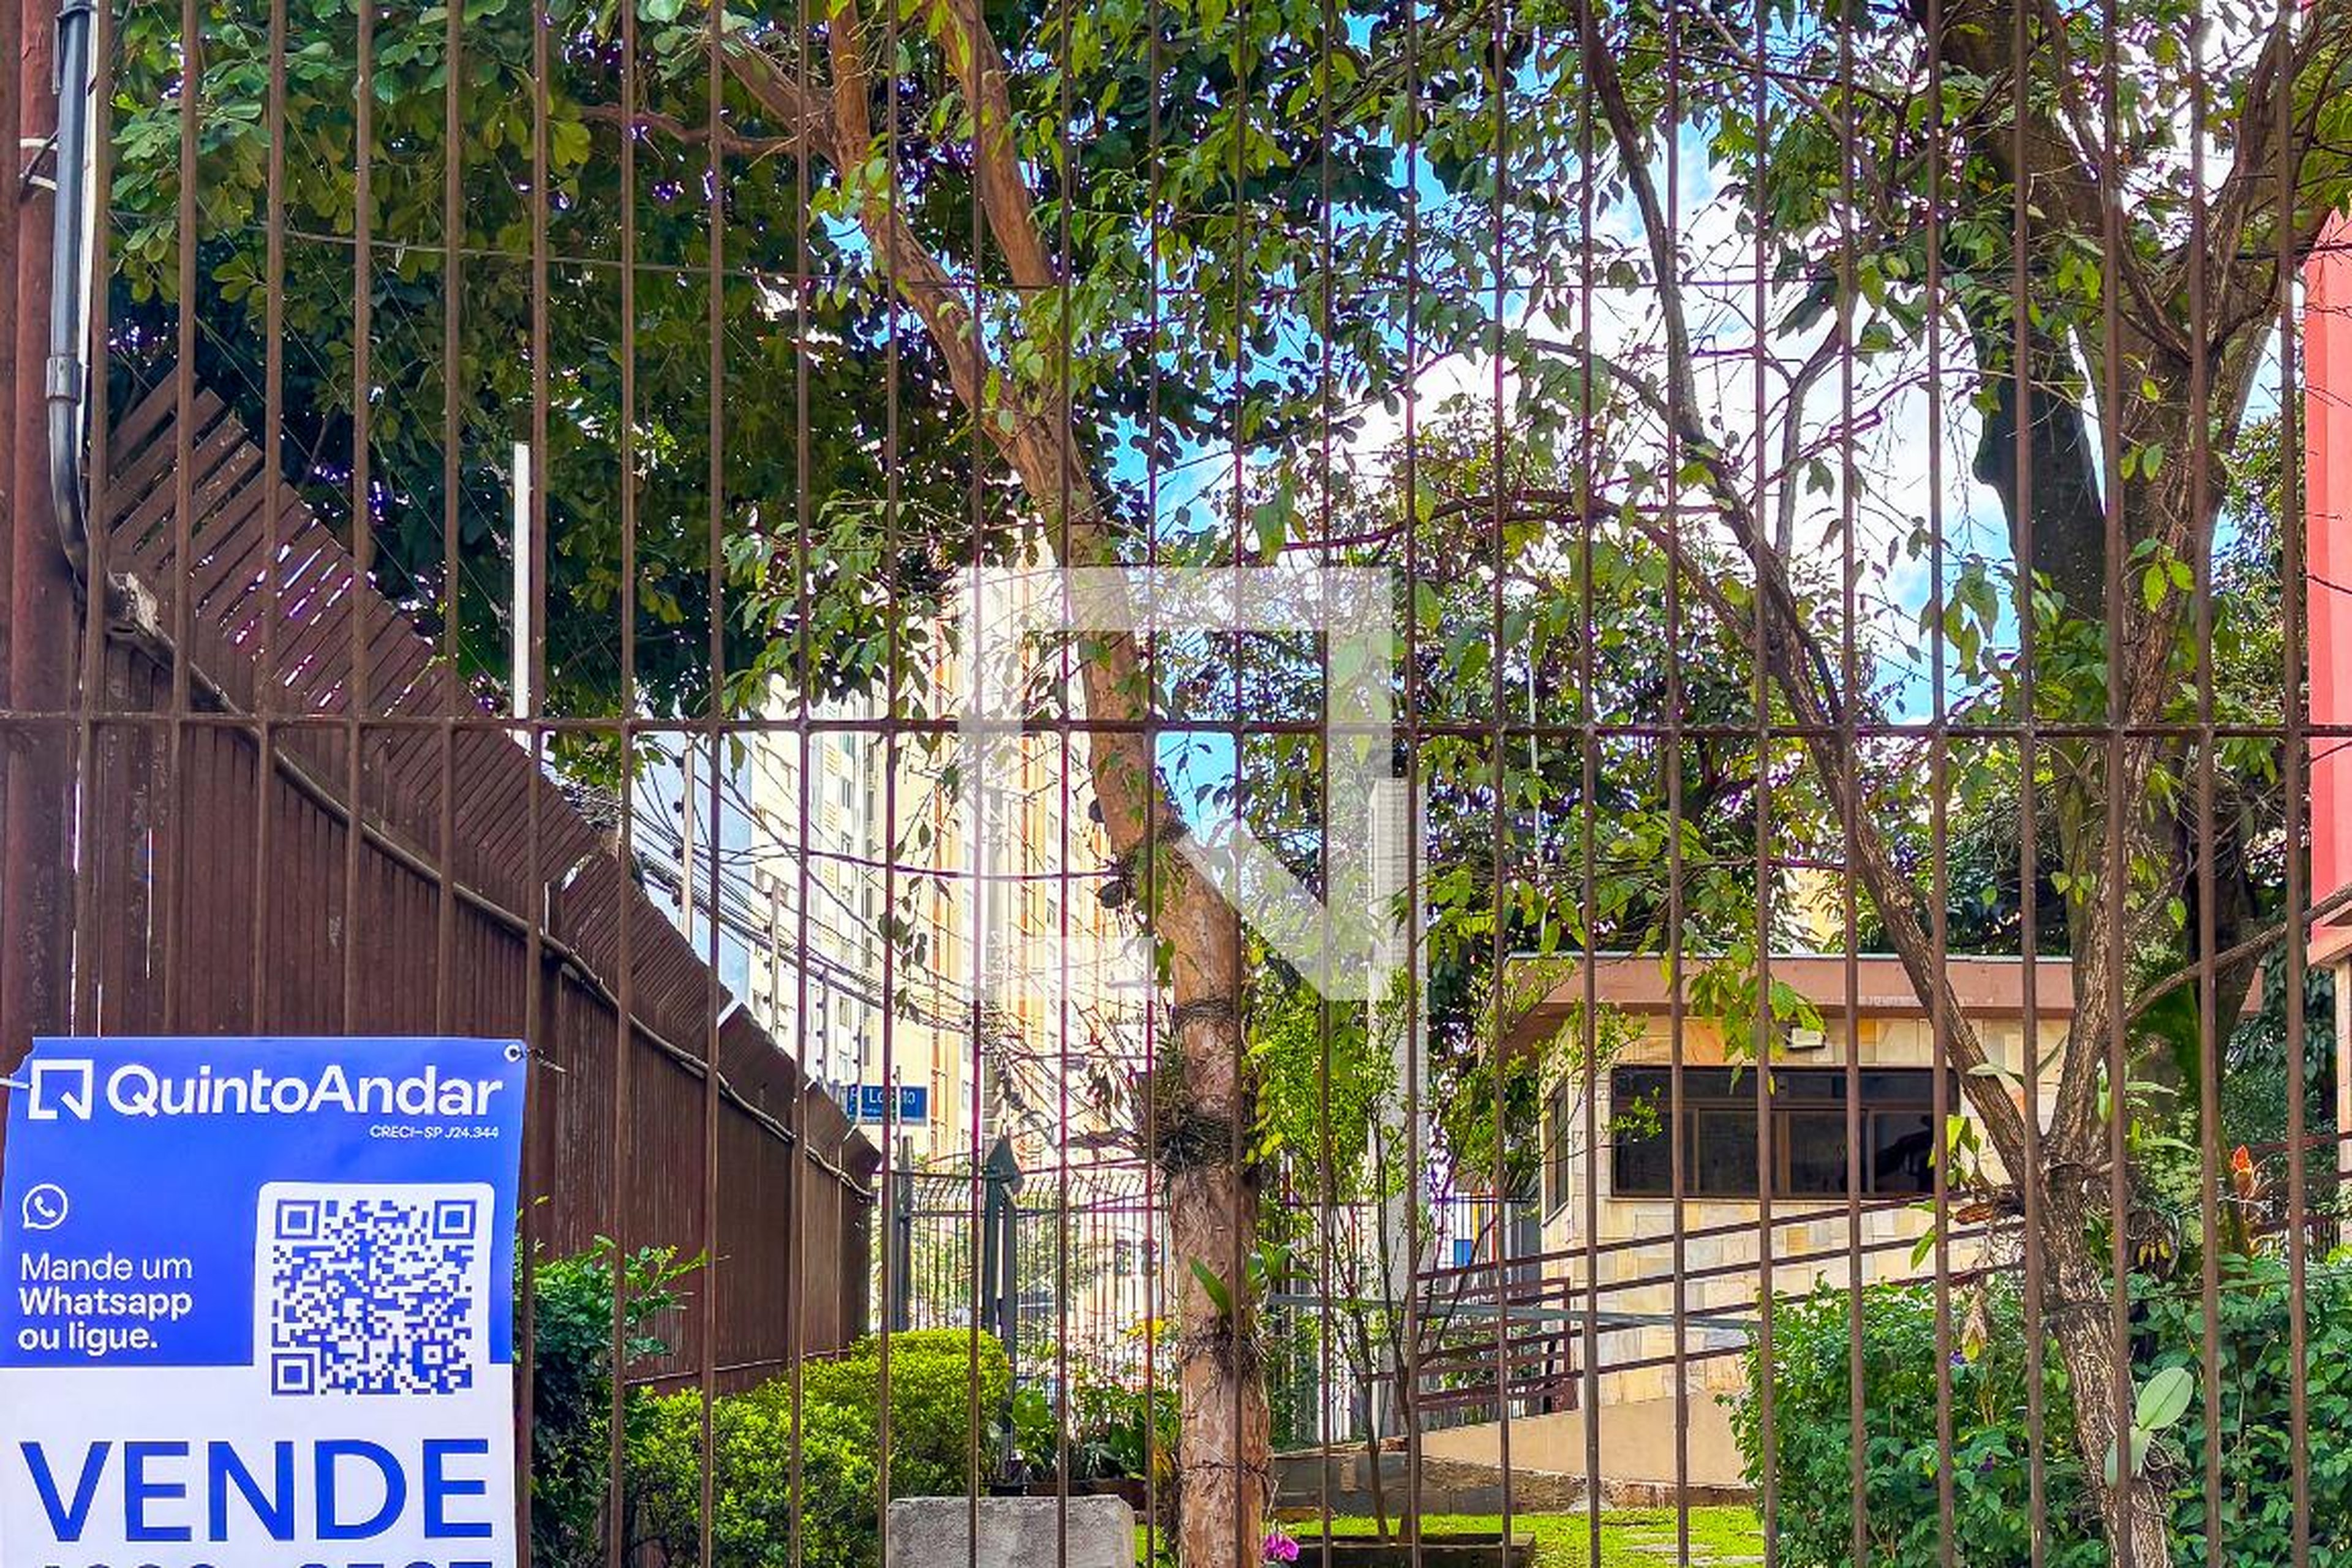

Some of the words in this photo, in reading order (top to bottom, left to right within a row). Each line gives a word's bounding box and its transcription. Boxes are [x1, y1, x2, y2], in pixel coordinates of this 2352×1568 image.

[107, 1063, 503, 1117] QuintoAndar
[370, 1125, 443, 1138] CRECI-SP
[445, 1126, 499, 1138] J24.344
[21, 1251, 133, 1281] Mande
[142, 1258, 192, 1280] um
[18, 1286, 192, 1321] Whatsapp
[18, 1329, 59, 1350] ou
[69, 1321, 157, 1356] ligue.
[20, 1439, 492, 1542] VENDE
